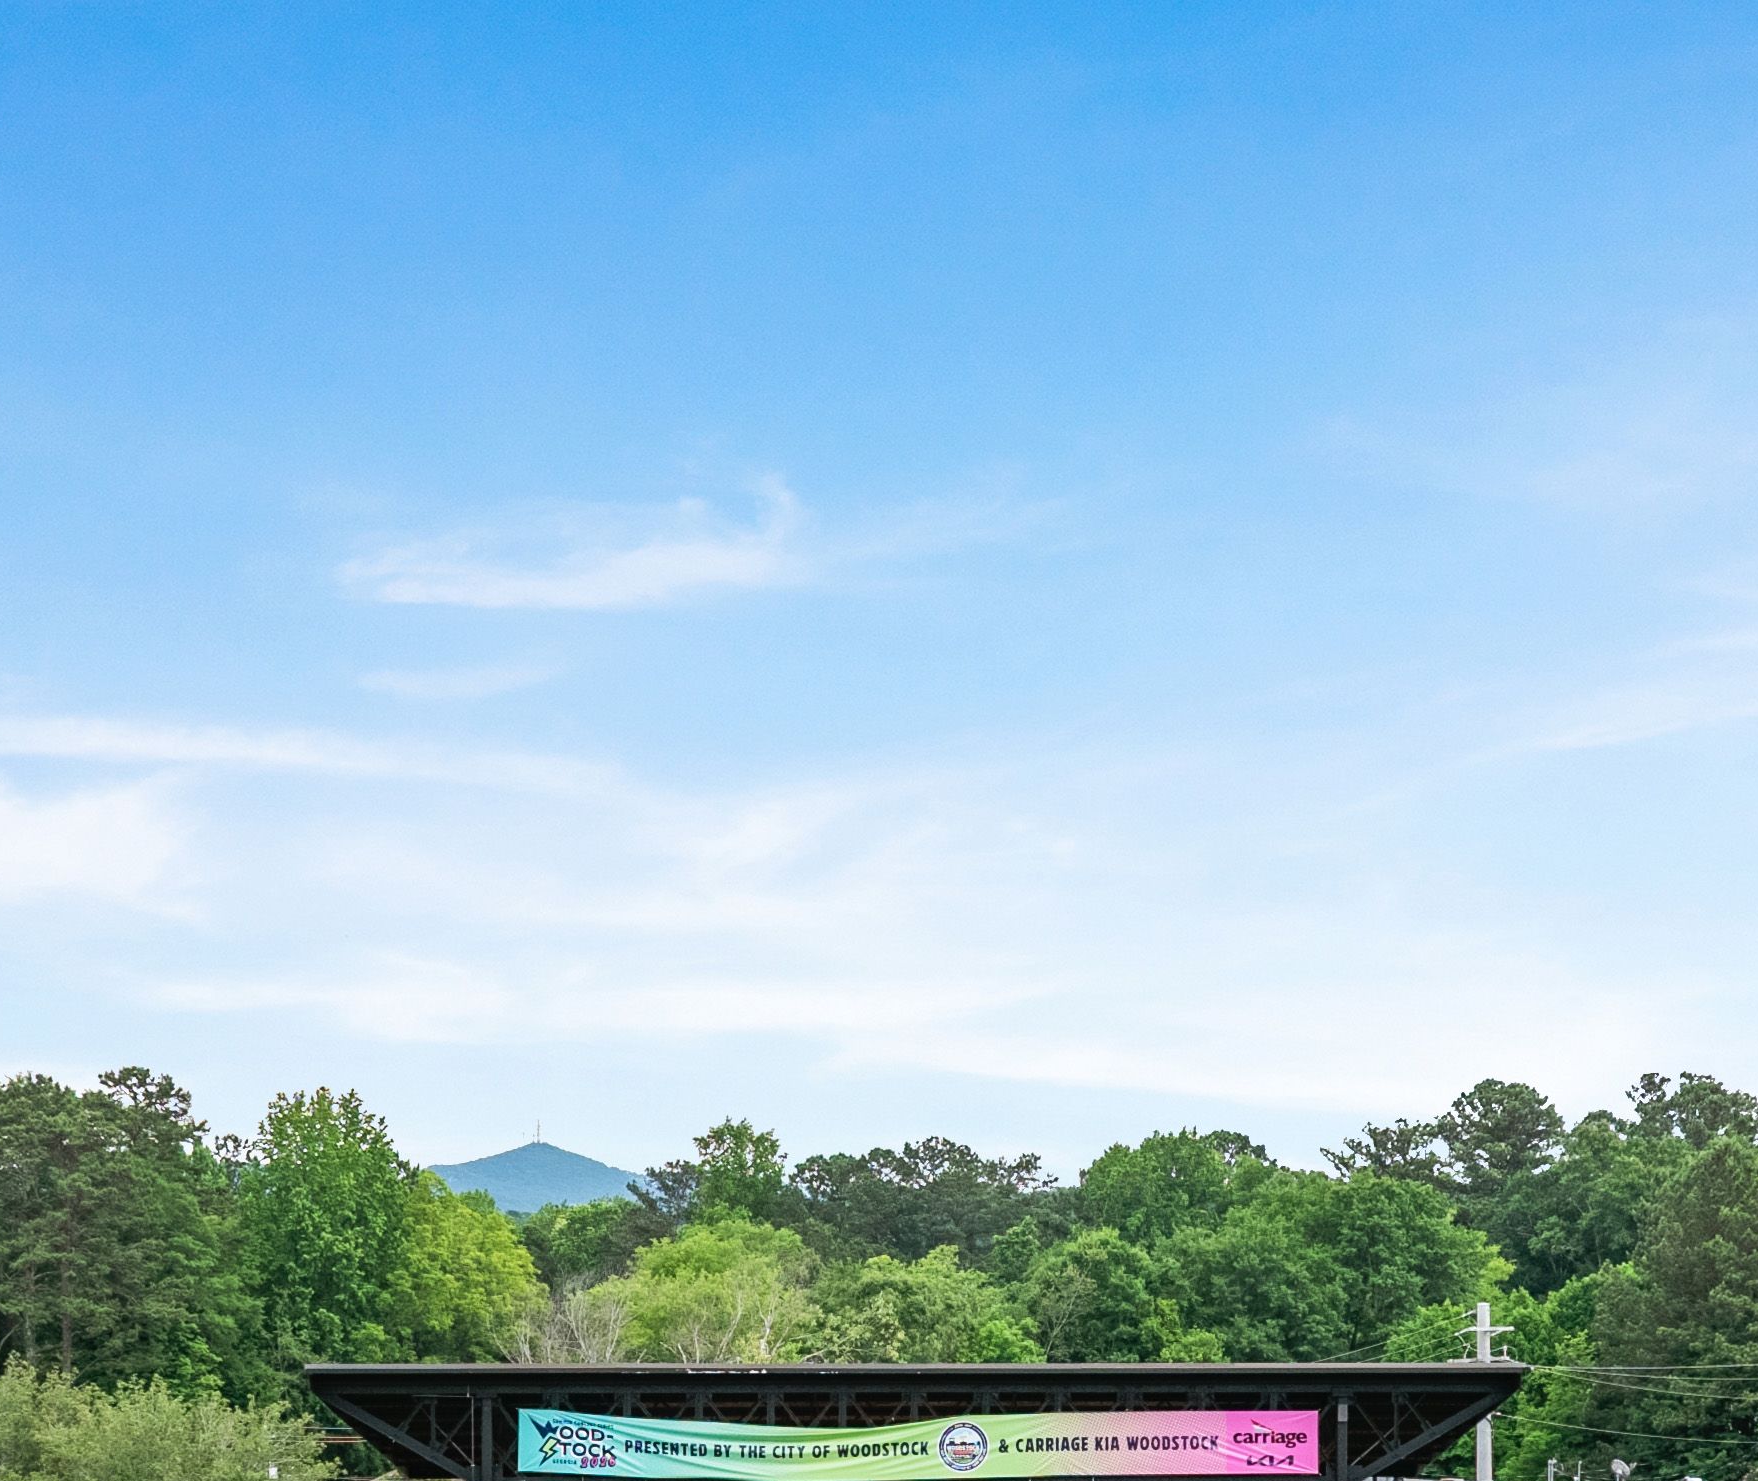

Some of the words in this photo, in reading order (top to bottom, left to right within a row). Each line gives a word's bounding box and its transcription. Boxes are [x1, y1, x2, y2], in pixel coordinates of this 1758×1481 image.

[624, 1440, 707, 1457] PRESENTED
[713, 1444, 731, 1458] BY
[739, 1445, 766, 1458] THE
[772, 1445, 805, 1458] CITY
[812, 1445, 831, 1458] OF
[837, 1441, 929, 1457] WOODSTOCK
[998, 1439, 1009, 1453] &
[1016, 1437, 1088, 1453] CARRIAGE
[1095, 1437, 1120, 1451] KIA
[1127, 1435, 1219, 1451] WOODSTOCK
[1233, 1430, 1307, 1448] carriage
